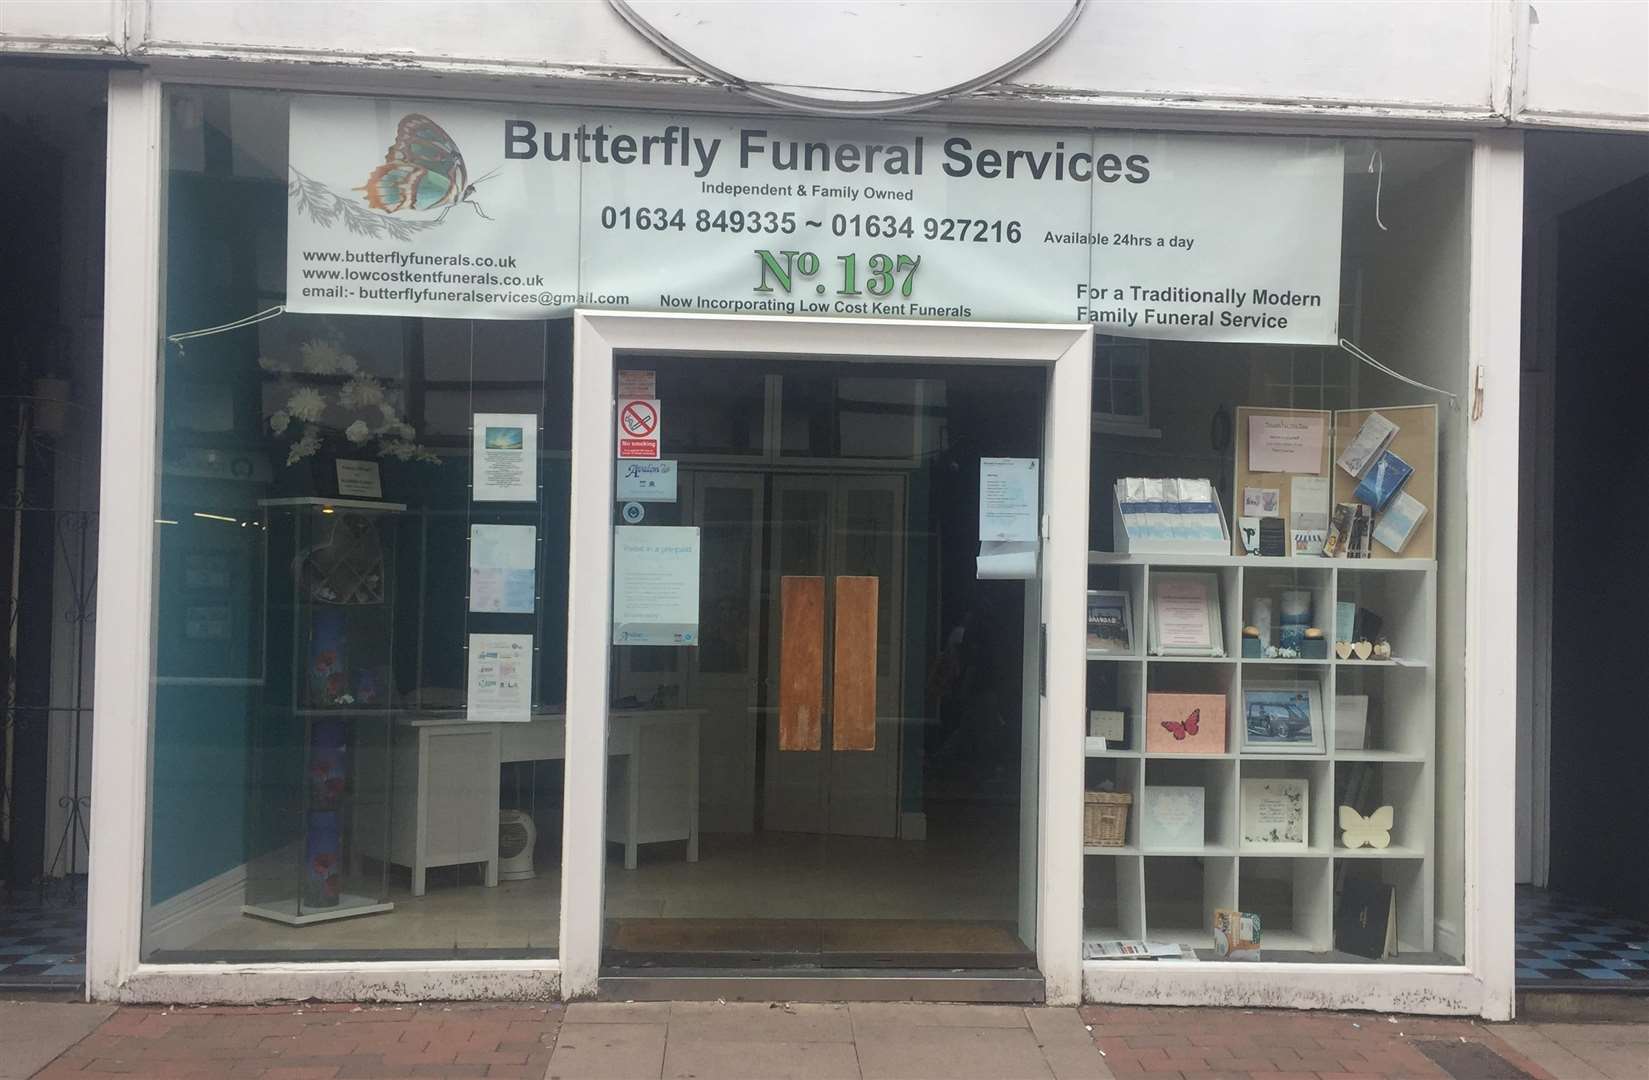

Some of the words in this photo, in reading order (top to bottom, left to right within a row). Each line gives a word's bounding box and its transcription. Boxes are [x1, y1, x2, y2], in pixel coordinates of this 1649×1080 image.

[505, 119, 721, 178] Butterfly
[740, 130, 922, 175] Funeral
[942, 137, 1150, 183] Services
[702, 181, 792, 197] Independent
[797, 185, 807, 196] &
[812, 185, 859, 201] Family
[864, 187, 913, 201] Owned
[602, 207, 686, 231] 01634
[696, 209, 796, 234] 849335
[832, 214, 914, 238] 01634
[924, 218, 1021, 243] 927216
[1044, 232, 1108, 245] Available
[1113, 234, 1152, 246] 24hrs
[1157, 238, 1164, 247] a
[1169, 236, 1194, 250] day
[303, 250, 516, 268] www.butterflyfunerals.co.uk
[303, 268, 543, 286] www.lowcostkentfunerals.co.uk
[836, 253, 921, 297] 137
[302, 286, 354, 298] email:-
[360, 286, 629, 306] butterflyfuneralservices@gmail.com
[660, 295, 692, 307] Now
[697, 296, 795, 314] Incorporating
[800, 300, 829, 313] Low
[834, 302, 867, 314] Cost
[872, 303, 904, 315] Kent
[910, 304, 971, 317] Funerals
[1077, 284, 1108, 300] For
[1114, 289, 1123, 300] a
[1130, 286, 1246, 306] Traditionally
[1253, 290, 1320, 306] Modern
[1077, 306, 1138, 326] Family
[1145, 309, 1213, 326] Funeral
[1220, 311, 1287, 328] Service
